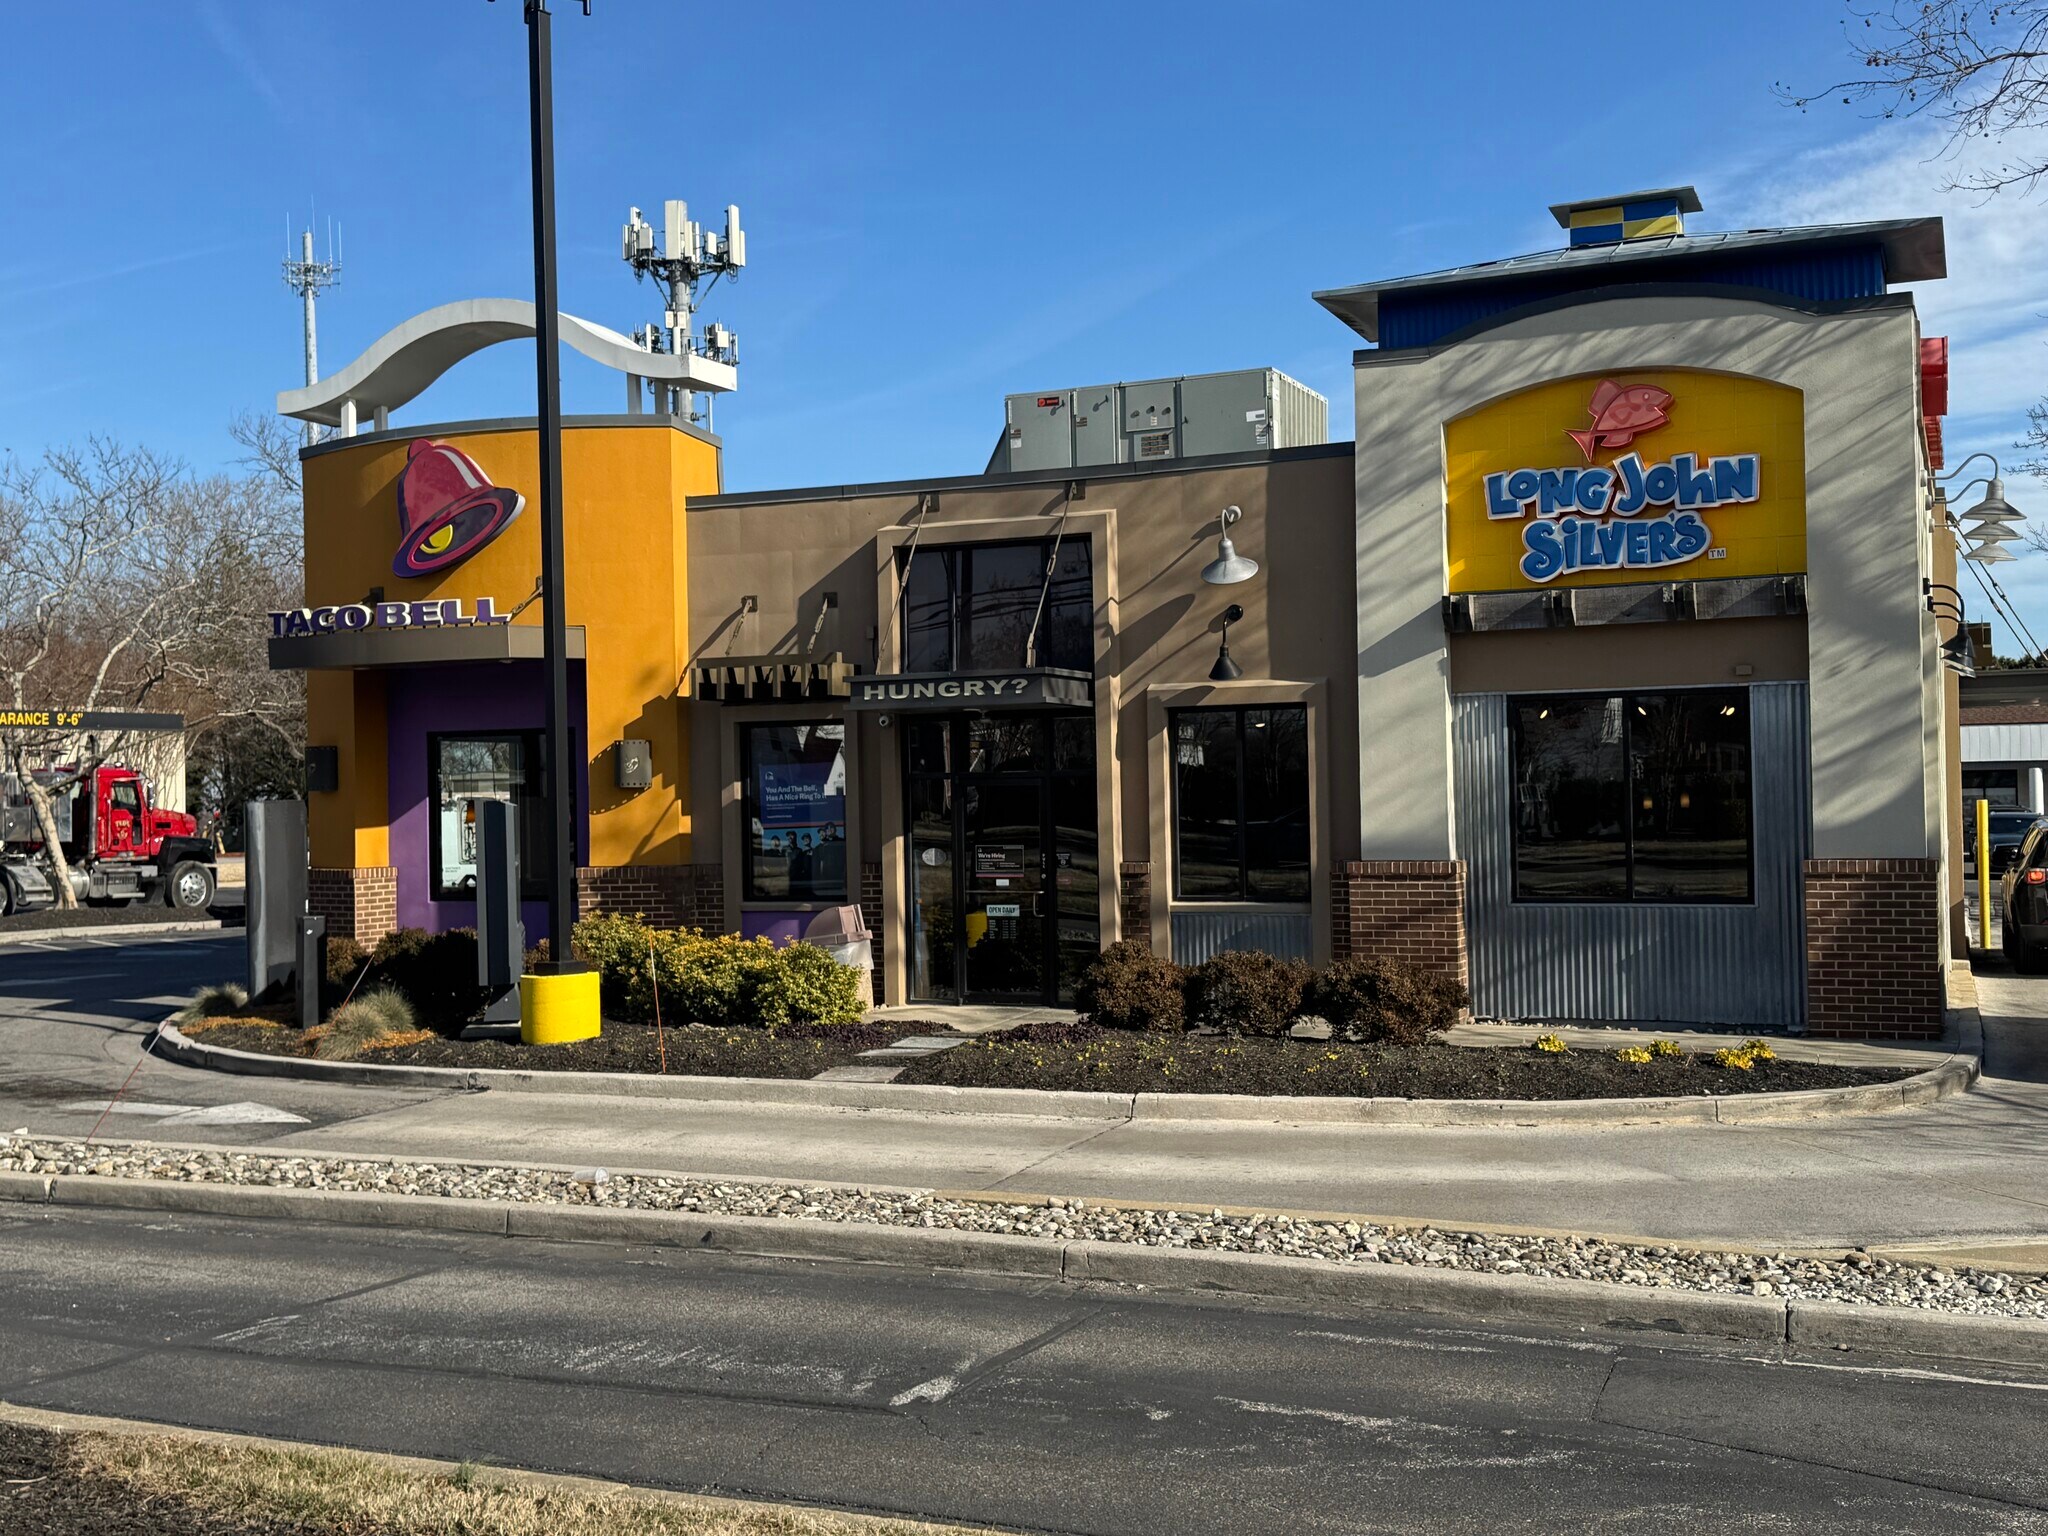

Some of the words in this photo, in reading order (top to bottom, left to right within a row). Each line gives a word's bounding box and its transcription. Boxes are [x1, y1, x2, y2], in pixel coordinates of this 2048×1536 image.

[1484, 467, 1617, 519] LONG
[268, 604, 373, 636] TACO
[376, 597, 512, 627] BELL
[863, 678, 1028, 700] HUNGRY?
[0, 712, 49, 725] ARANCE
[778, 785, 791, 793] And
[786, 793, 799, 801] Nice
[799, 792, 814, 801] Ring
[989, 906, 1002, 914] OPEN
